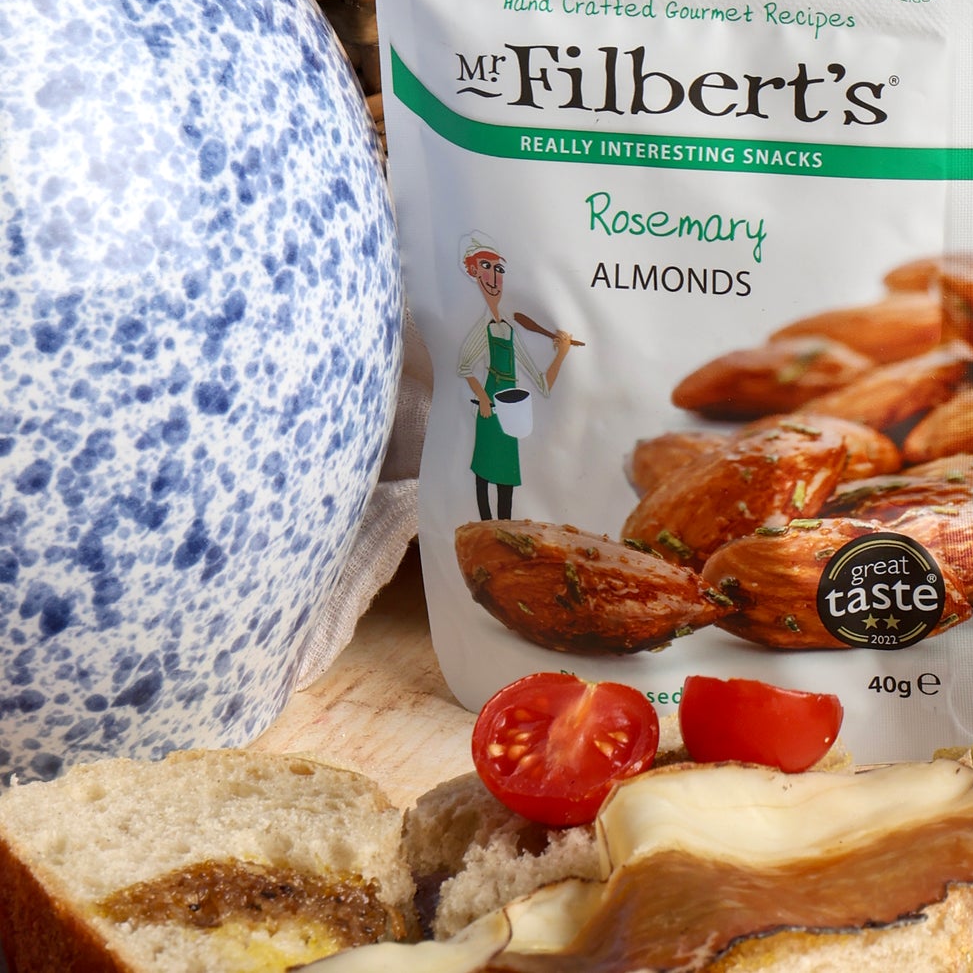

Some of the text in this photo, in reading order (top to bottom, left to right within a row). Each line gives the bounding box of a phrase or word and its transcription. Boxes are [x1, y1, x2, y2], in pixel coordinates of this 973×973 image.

[665, 0, 754, 23] Gourmet
[764, 2, 856, 39] Recipes
[520, 135, 823, 168] REALLY INTERESTING SNACKS
[585, 191, 767, 263] Rosemary
[590, 262, 752, 297] ALMONDS
[851, 556, 910, 586] great
[871, 634, 899, 645] 2022
[868, 675, 912, 698] 40g
